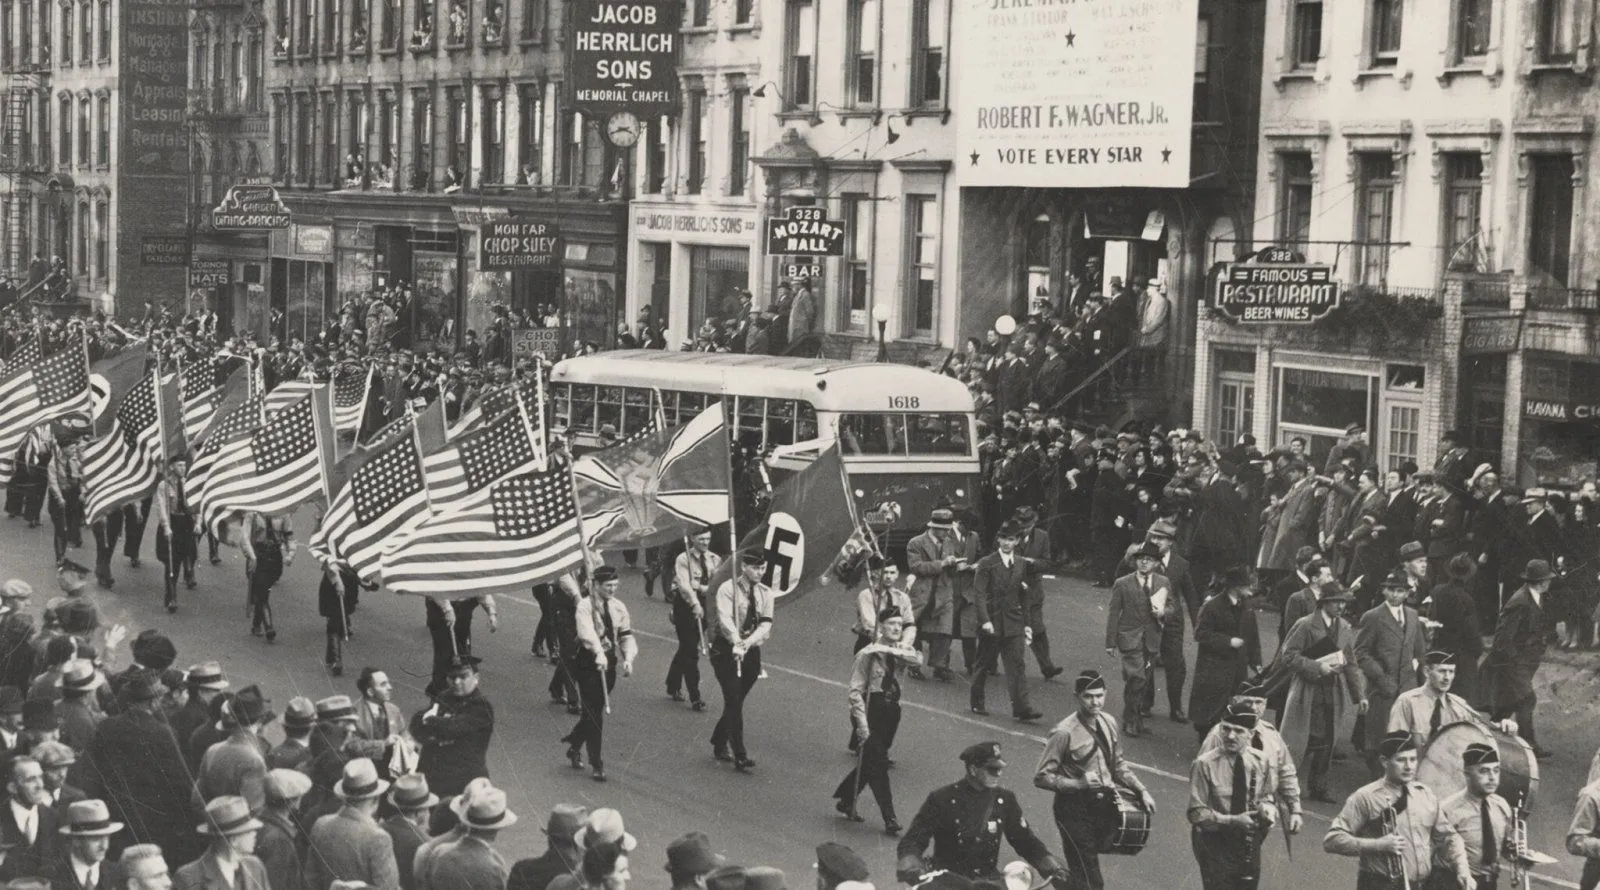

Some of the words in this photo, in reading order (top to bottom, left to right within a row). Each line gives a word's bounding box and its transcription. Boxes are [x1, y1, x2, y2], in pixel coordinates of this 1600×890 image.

[591, 4, 657, 25] JACOB
[576, 31, 673, 53] HERRLICH
[596, 59, 652, 80] SONS
[576, 89, 629, 102] MEMORIAL
[631, 90, 671, 103] CHAPEL
[977, 105, 1043, 130] ROBERT
[997, 147, 1037, 165] VOTE
[1045, 147, 1101, 165] EVERY
[1106, 146, 1143, 164] STAR
[795, 209, 821, 220] 328
[494, 224, 520, 236] MON
[721, 216, 743, 234] SONS
[774, 220, 843, 240] MOZART
[484, 237, 520, 254] CHOP
[522, 237, 557, 253] SUEY
[786, 237, 829, 252] HALL
[488, 254, 553, 267] RESTAURANT
[191, 273, 229, 285] HATS
[788, 265, 821, 278] BAR
[1252, 268, 1308, 283] FAMOUS
[1223, 284, 1333, 305] RESTAURANT
[1244, 305, 1309, 320] BEER-WINES
[1463, 333, 1516, 349] CIGARS
[887, 395, 920, 410] 1618
[1525, 401, 1567, 419] HAVANA
